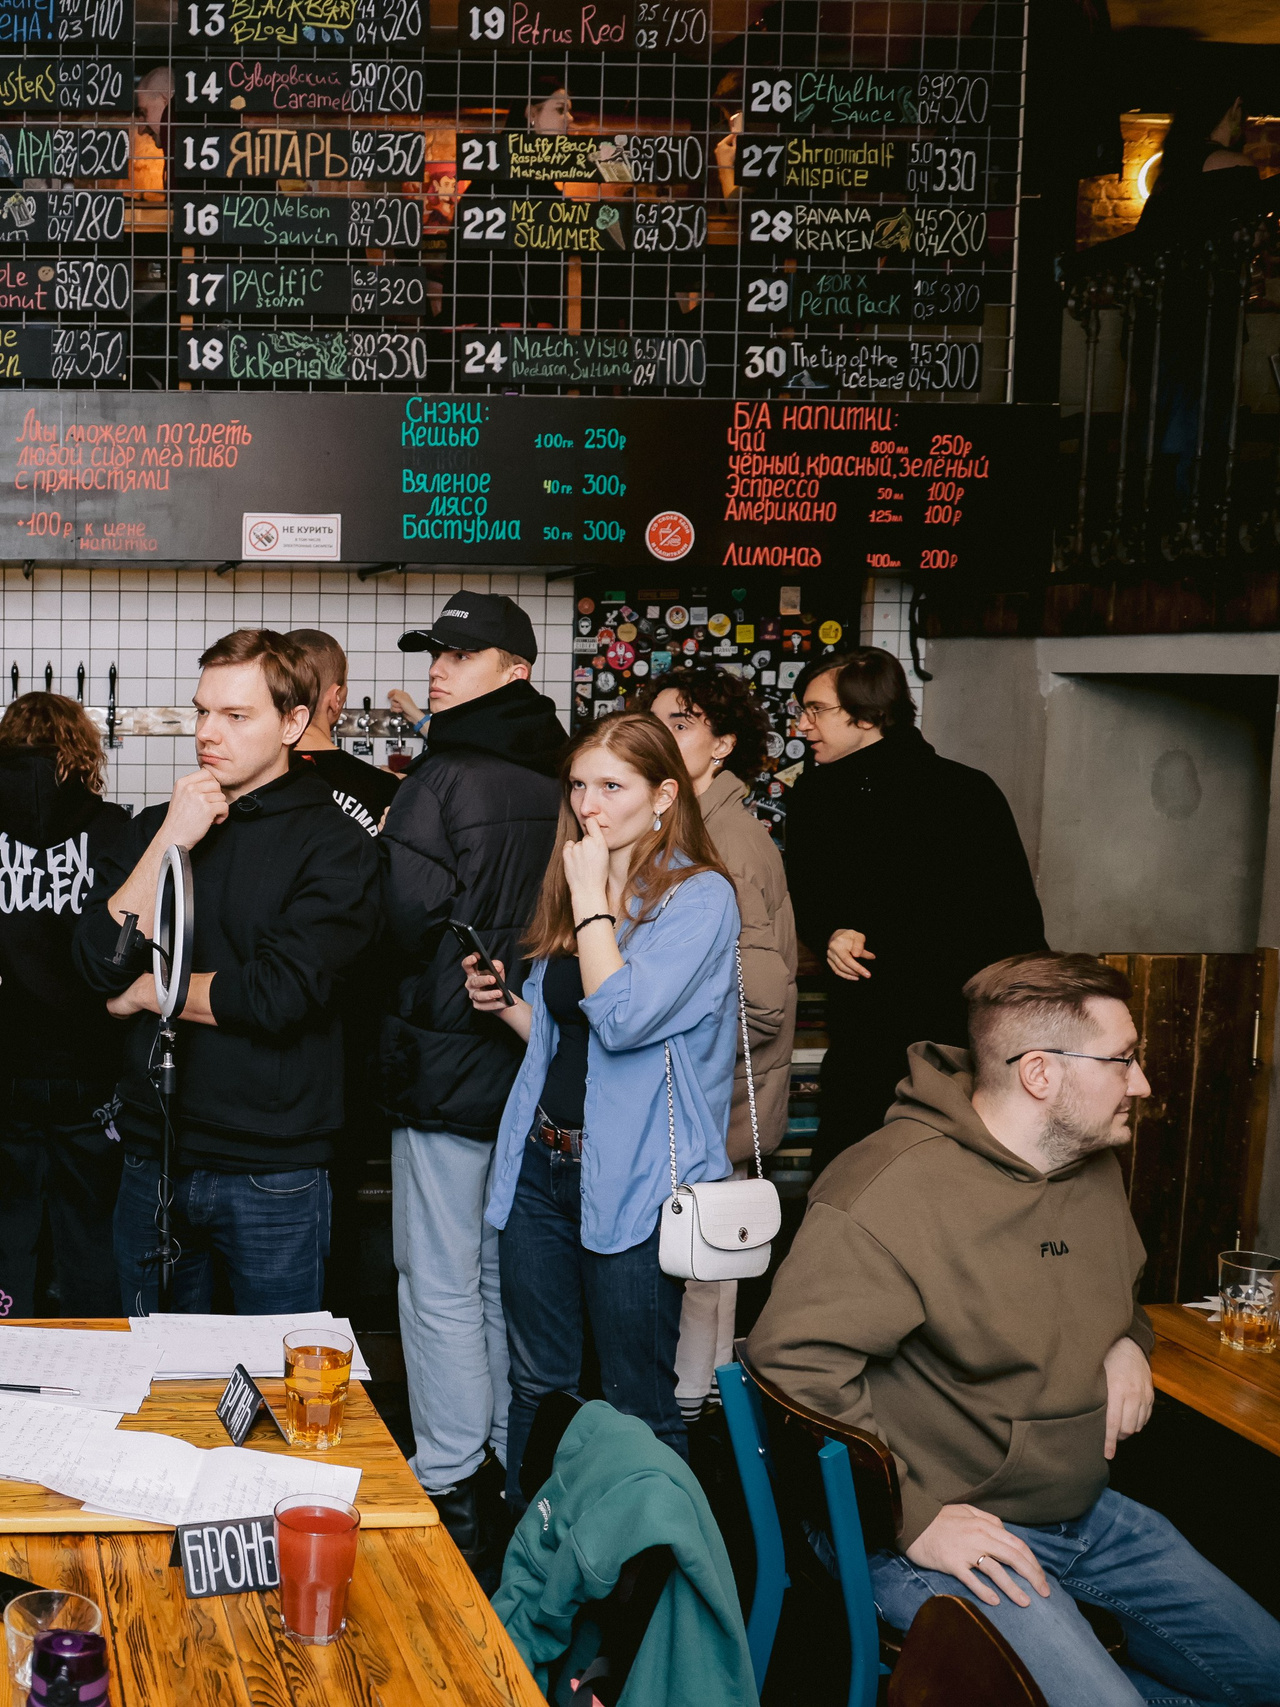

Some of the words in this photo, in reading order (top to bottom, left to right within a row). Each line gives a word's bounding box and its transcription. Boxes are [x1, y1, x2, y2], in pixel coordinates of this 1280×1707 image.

[187, 3, 226, 36] 13
[469, 6, 506, 41] 19
[511, 2, 574, 45] Petrus
[581, 4, 626, 45] Red
[85, 63, 123, 106] 320
[185, 70, 222, 104] 14
[228, 62, 342, 92] Суворовский
[378, 64, 423, 112] 280
[273, 85, 352, 112] Caramel
[751, 80, 793, 113] 26
[800, 73, 895, 103] Cthulhu
[941, 77, 989, 124] 320
[16, 128, 53, 176] APA
[80, 129, 130, 177] 320
[183, 136, 220, 170] 15
[226, 129, 349, 178] ЯНТАРЬ
[376, 132, 426, 177] 350
[462, 139, 500, 172] 21
[654, 136, 703, 181] 340
[742, 144, 785, 178] 27
[932, 148, 976, 192] 330
[73, 192, 125, 242] 280
[183, 201, 220, 236] 16
[272, 197, 331, 220] Nelson
[373, 198, 421, 247] 320
[262, 222, 338, 246] Sauvin
[463, 206, 507, 240] 22
[511, 200, 543, 222] MY
[548, 202, 592, 224] OWN
[659, 204, 708, 251] 350
[750, 209, 794, 243] 28
[794, 206, 872, 226] BANANA
[936, 210, 988, 257] 280
[513, 222, 606, 251] SUMMER
[795, 229, 876, 253] KRAKEN
[80, 261, 130, 310] 280
[187, 272, 225, 307] 17
[379, 277, 424, 306] 320
[747, 279, 789, 313] 29
[940, 282, 980, 313] 380
[76, 330, 124, 378] 350
[187, 337, 224, 371] 18
[377, 334, 427, 380] 330
[465, 340, 508, 374] 24
[660, 338, 706, 386] 400
[745, 346, 787, 378] 30
[935, 343, 980, 390] 300
[14, 407, 57, 443] Мы
[64, 420, 146, 446] можем
[156, 420, 252, 447] погреть
[405, 397, 490, 424] Снэки:
[734, 401, 772, 431] Б/А
[782, 404, 900, 432] напитки:
[402, 420, 480, 447] Кешью
[726, 428, 766, 452] Чай
[16, 442, 82, 468] любой
[90, 446, 136, 476] сидр
[187, 445, 238, 469] пиво
[33, 465, 171, 494] пряностями
[402, 468, 492, 494] Вяленое
[725, 474, 820, 502] Эспрессо
[425, 495, 488, 518] мясо
[724, 498, 838, 525] Американо
[104, 521, 147, 540] цене
[282, 525, 295, 534] НЕ
[297, 525, 334, 535] КУРИТЬ
[402, 514, 522, 545] Бастурма
[722, 542, 822, 567] Лимонад
[1040, 1240, 1070, 1258] FILA
[183, 1521, 282, 1596] БРОНЬ
